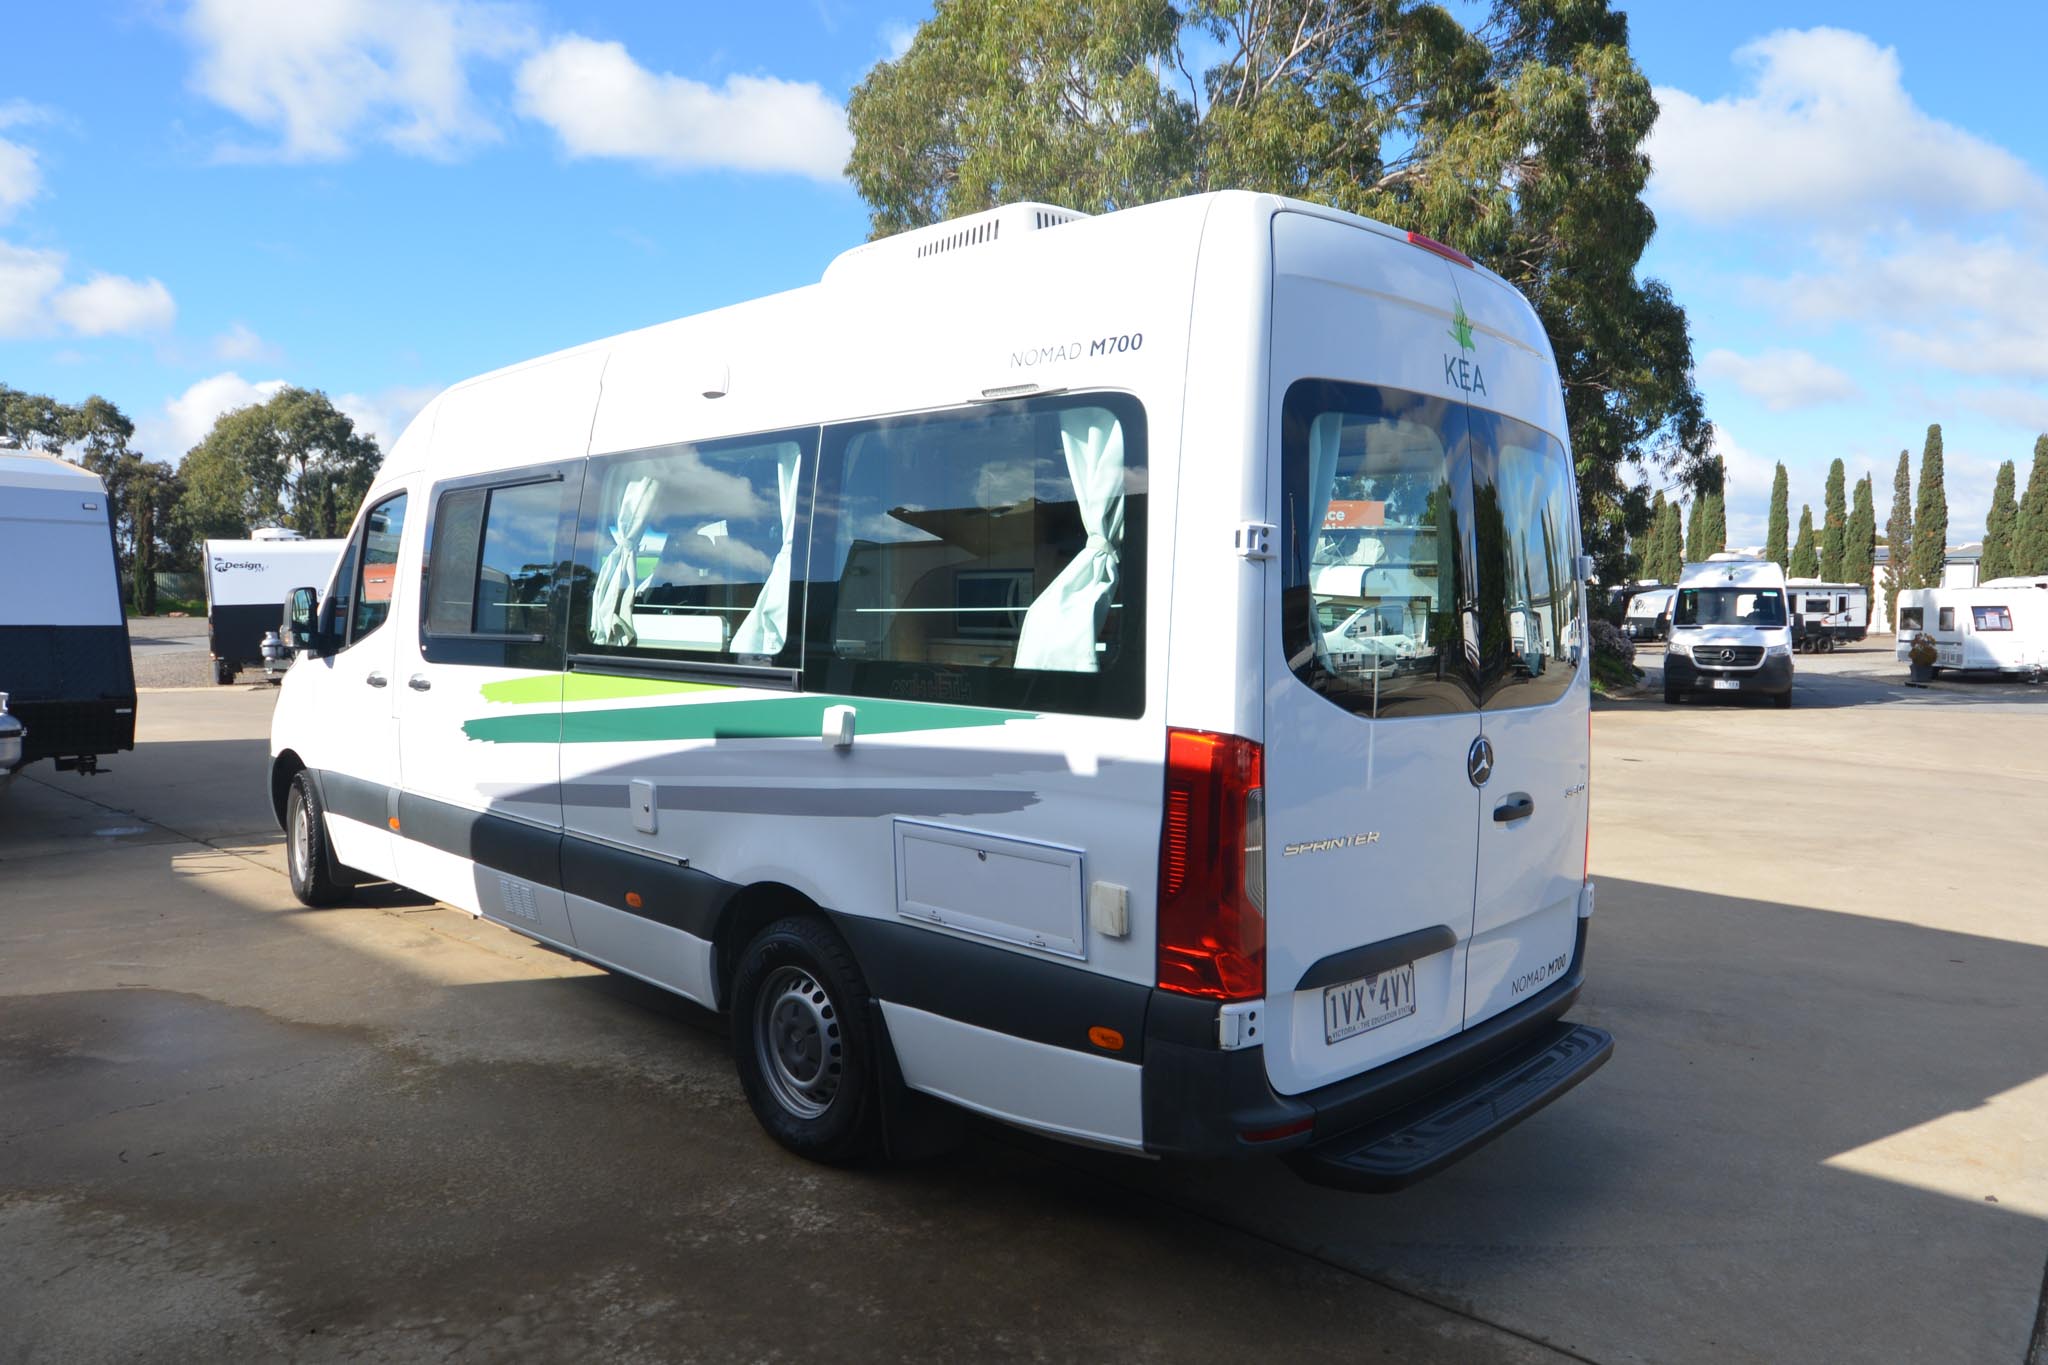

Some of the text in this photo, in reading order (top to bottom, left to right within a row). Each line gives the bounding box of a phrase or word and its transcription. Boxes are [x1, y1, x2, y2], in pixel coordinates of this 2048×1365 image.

[1010, 333, 1143, 368] NOMAD M700
[1443, 352, 1487, 397] KEA
[225, 561, 261, 570] Design
[1282, 831, 1380, 857] SPRINTER
[1511, 952, 1567, 997] NOMAD M700
[1332, 1025, 1356, 1039] VICTORIA
[1361, 1020, 1370, 1030] THE
[1371, 1011, 1397, 1026] EDUCATION
